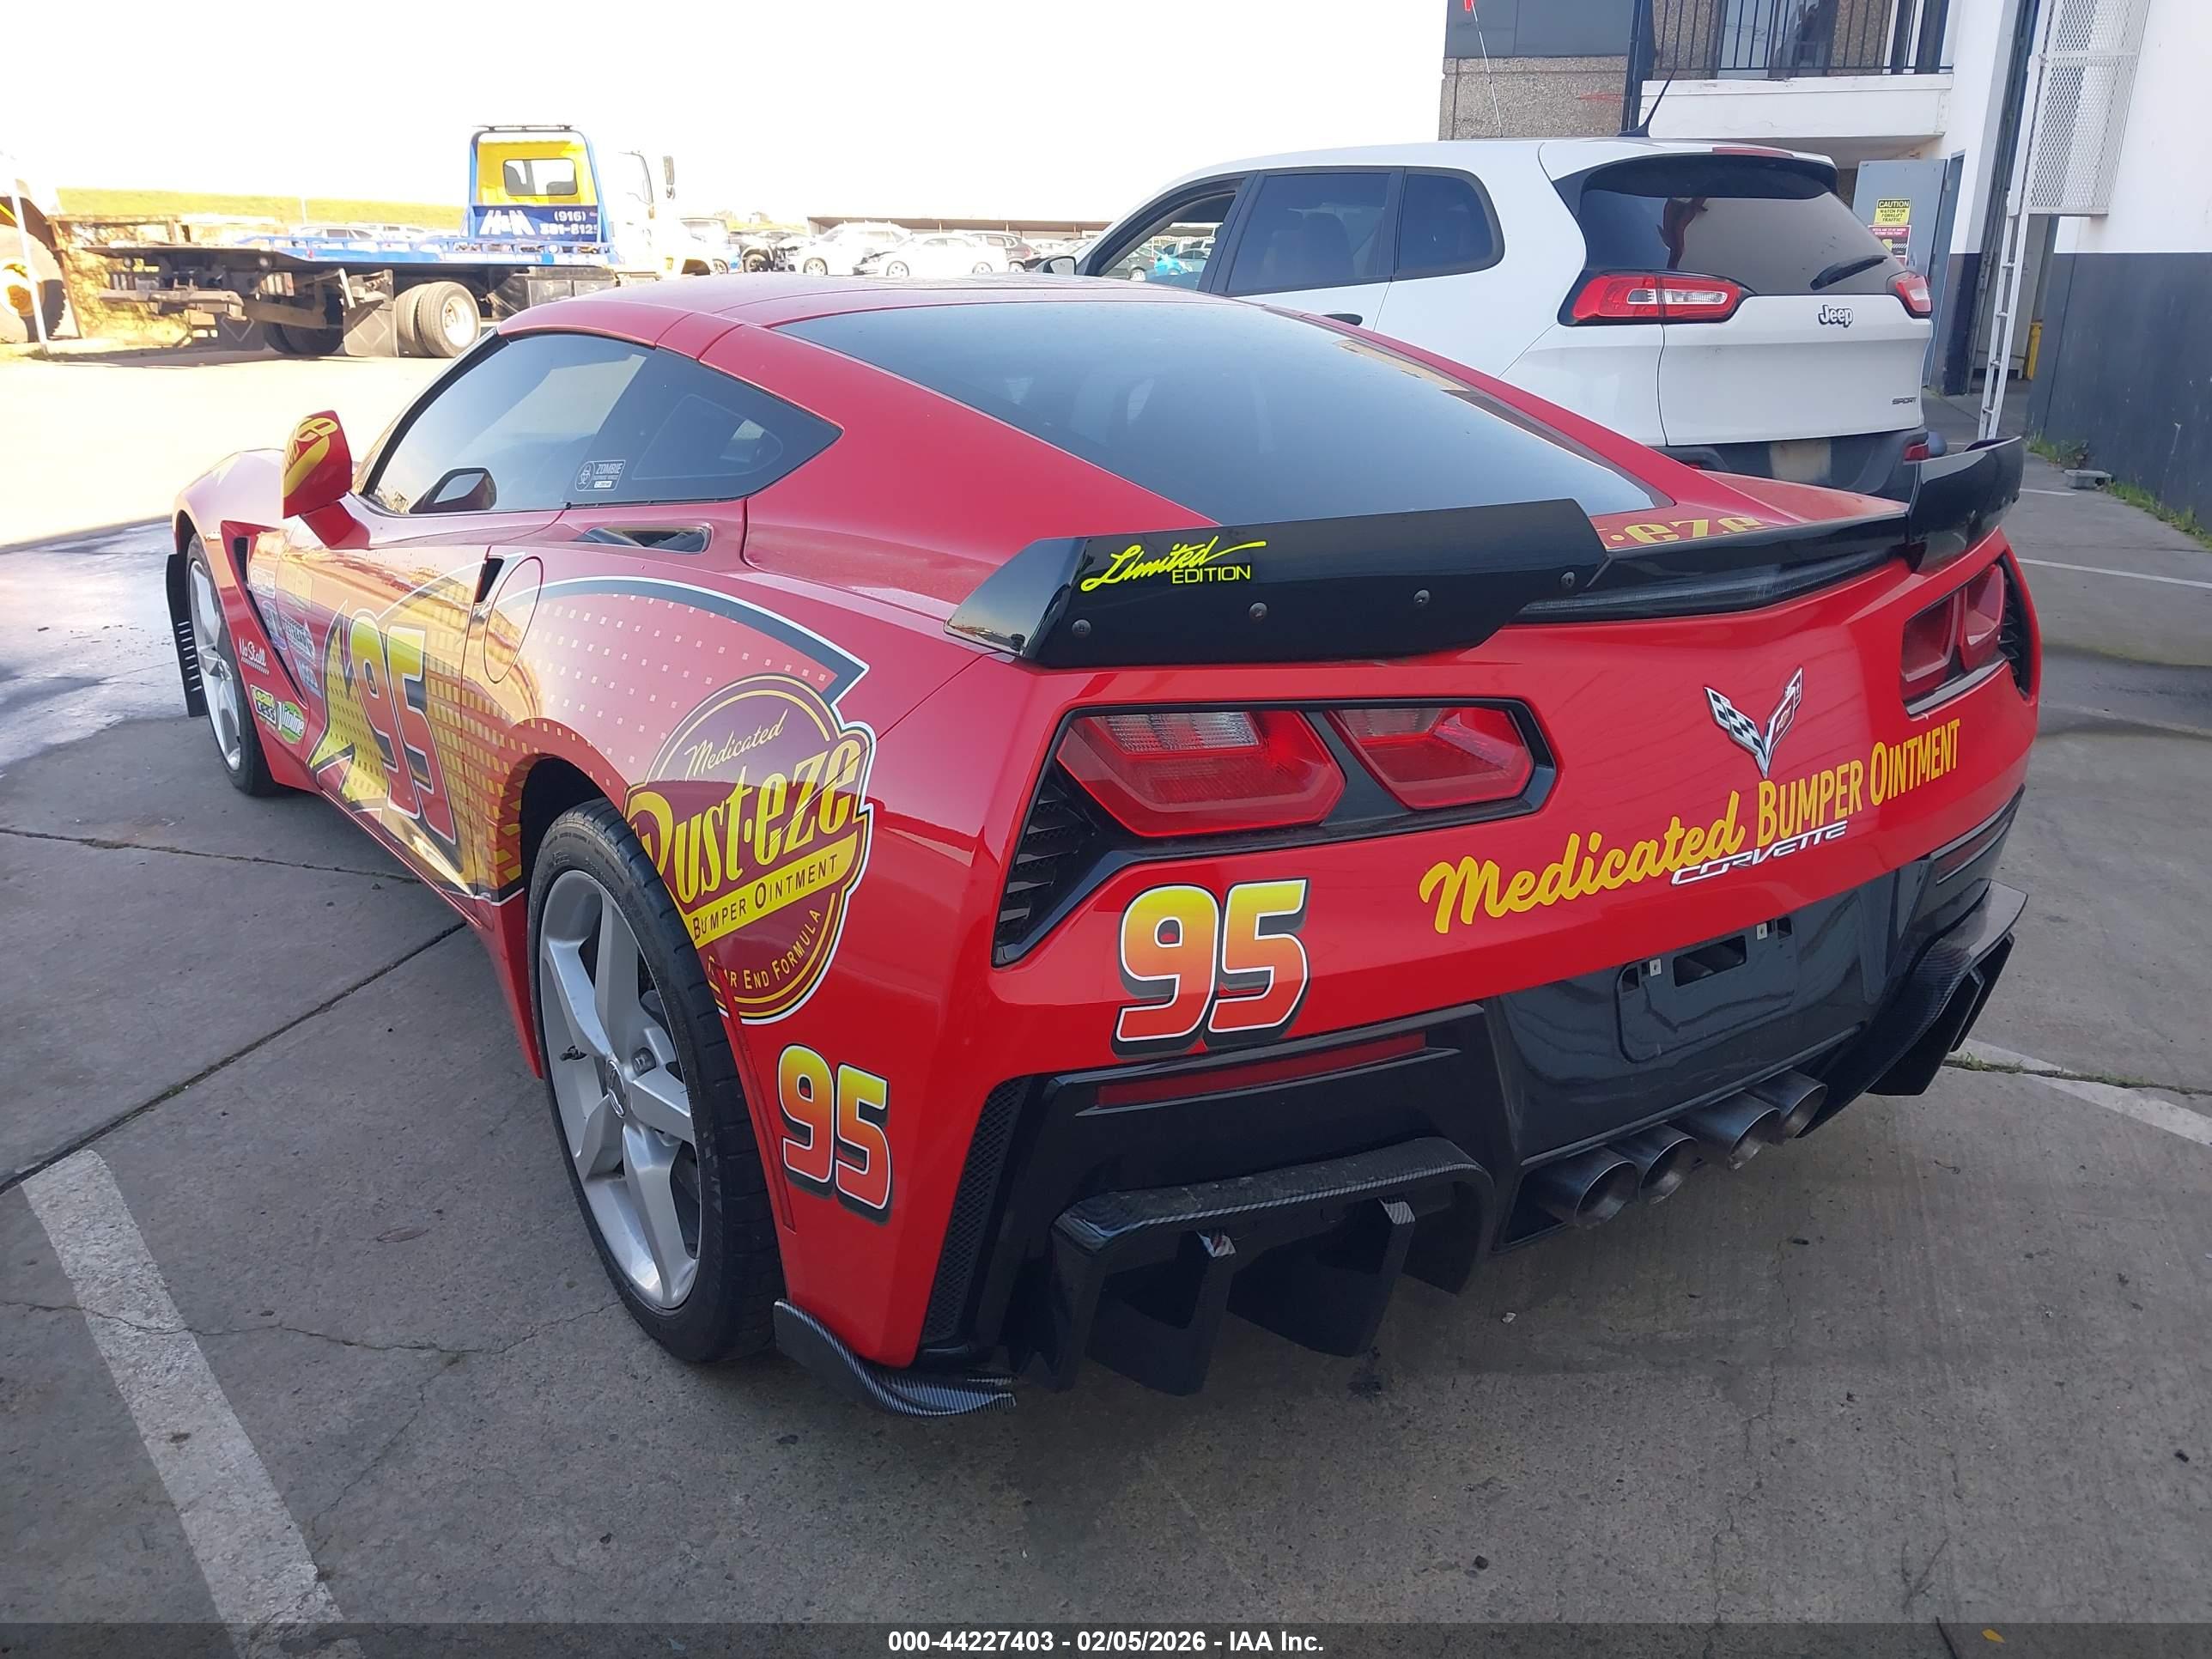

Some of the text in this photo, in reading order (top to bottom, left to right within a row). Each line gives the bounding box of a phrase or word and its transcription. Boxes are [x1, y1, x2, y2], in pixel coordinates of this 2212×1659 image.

[554, 211, 586, 221] (916)
[1819, 305, 1853, 328] Jeep
[596, 464, 623, 474] ZOMBIE
[1080, 535, 1267, 592] Limited
[1172, 565, 1251, 584] EDITION
[349, 608, 457, 845] 95
[684, 708, 789, 777] Medicated
[1419, 719, 1961, 934] Medicated BUMPER OINTMENT
[1670, 821, 1849, 886] CORVETTE
[692, 854, 838, 941] BUMPER OINTMENT
[744, 969, 769, 989] END
[771, 908, 822, 981] FORMULA
[1114, 878, 1310, 1060] 95
[777, 1043, 895, 1224] 95
